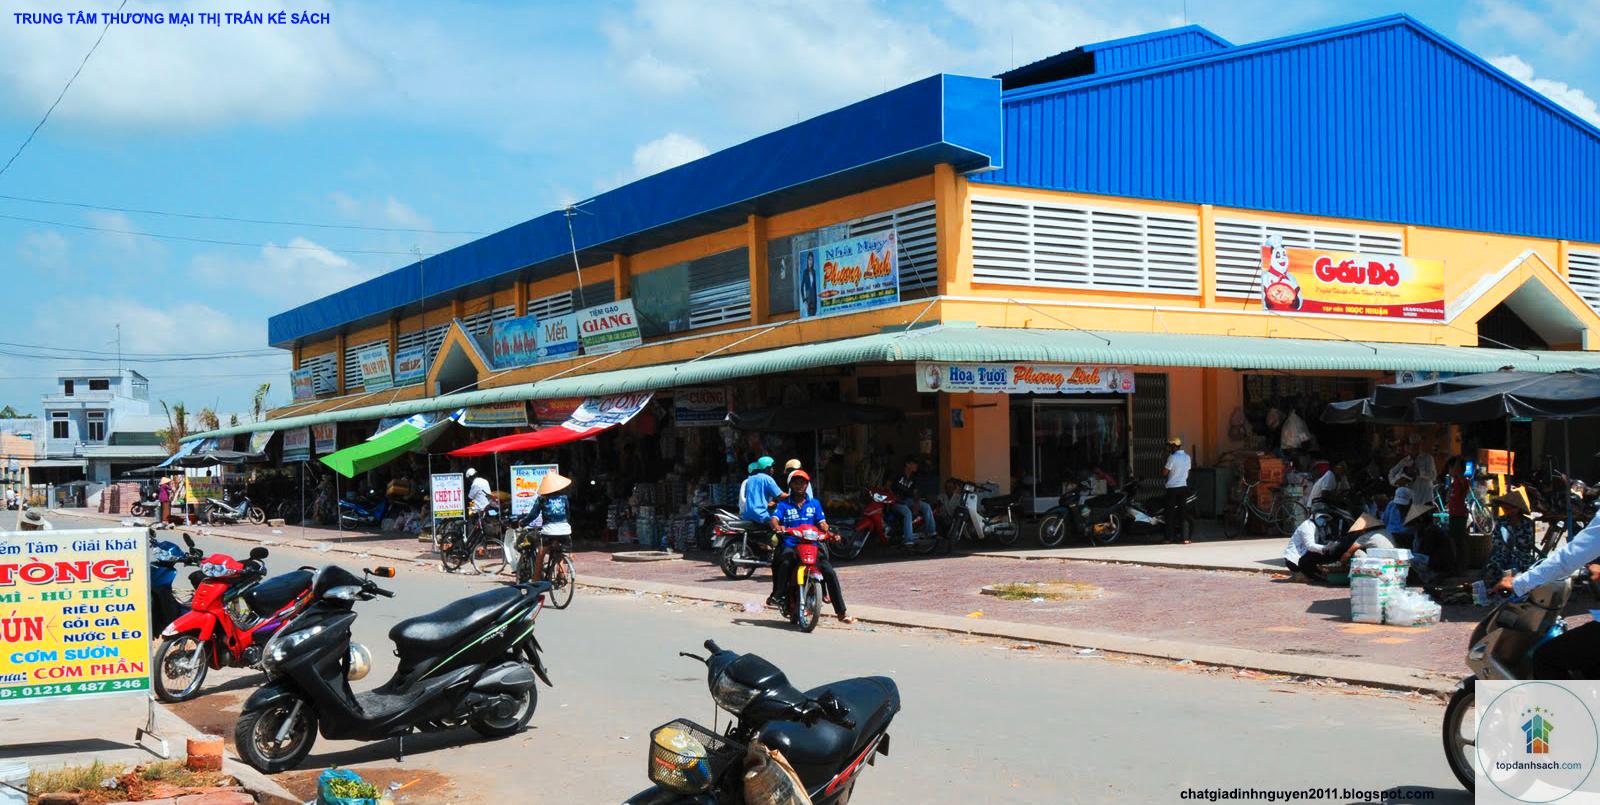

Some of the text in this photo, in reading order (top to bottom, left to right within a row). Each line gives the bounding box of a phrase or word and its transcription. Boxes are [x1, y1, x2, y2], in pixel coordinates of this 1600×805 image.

[1315, 257, 1400, 287] Gấu Đỏ
[582, 312, 632, 333] GIANG
[950, 366, 975, 384] Hoa
[25, 541, 58, 554] Tâm
[105, 538, 137, 551] Khát
[79, 584, 129, 600] TIẾU
[62, 603, 136, 615] RIÊU CUA
[0, 610, 44, 643] ÚN
[64, 631, 106, 643] NƯỚC
[10, 649, 57, 664] CƠM
[34, 665, 83, 680] CƠM
[90, 658, 144, 676] PHẦN
[22, 682, 73, 697] 01214
[77, 681, 106, 693] 487
[112, 679, 142, 690] 346
